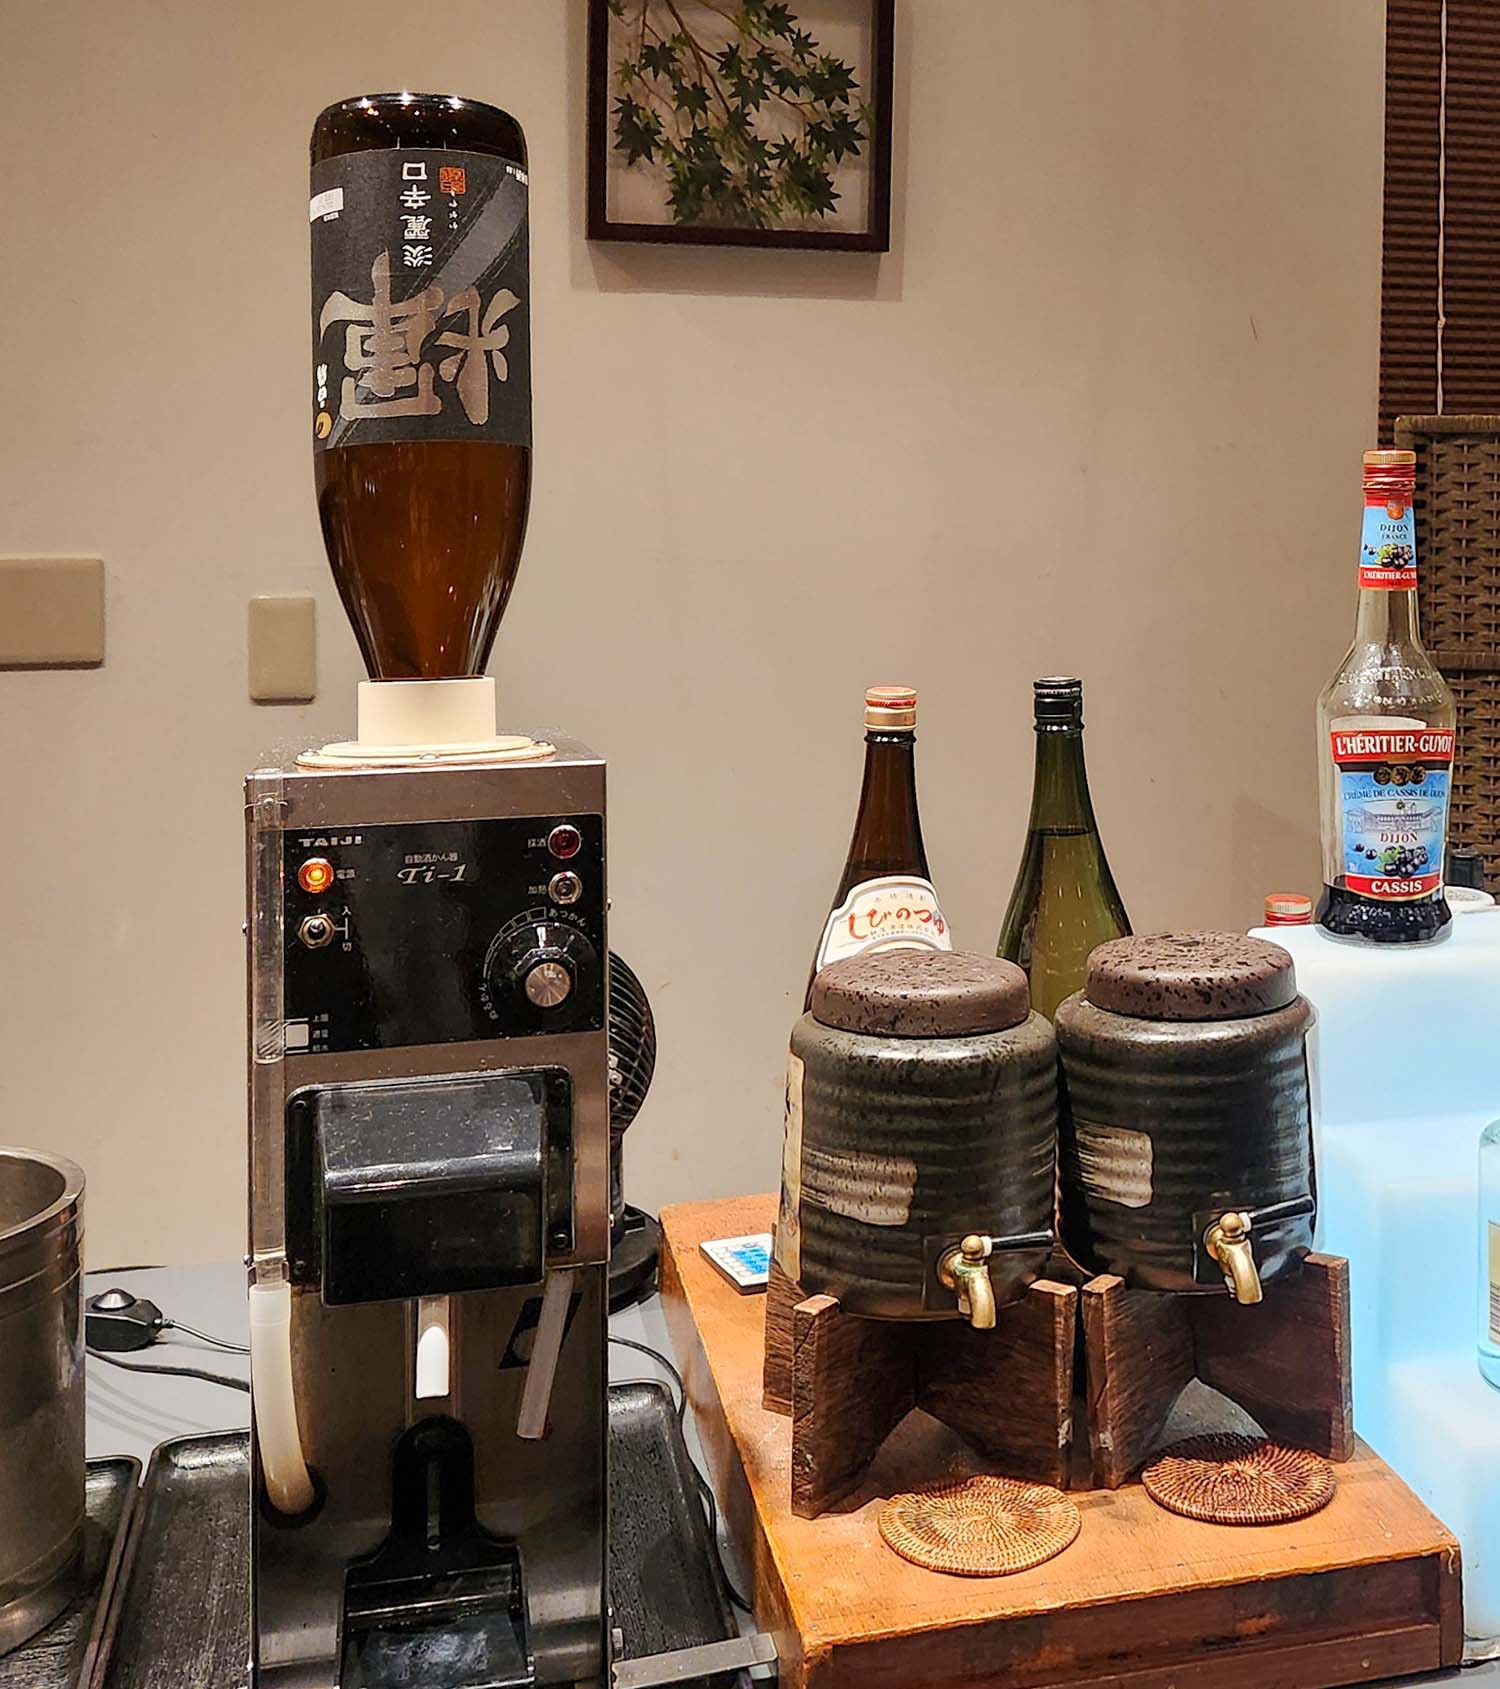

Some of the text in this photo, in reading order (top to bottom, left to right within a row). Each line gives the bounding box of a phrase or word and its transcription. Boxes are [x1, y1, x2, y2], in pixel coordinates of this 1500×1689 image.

[399, 161, 433, 268] 淡麗辛口
[1380, 523, 1409, 532] DIJON
[297, 836, 363, 848] TAIJI
[1379, 833, 1418, 843] DIJON
[396, 864, 467, 885] Ti-1
[1371, 880, 1423, 894] CASSIS
